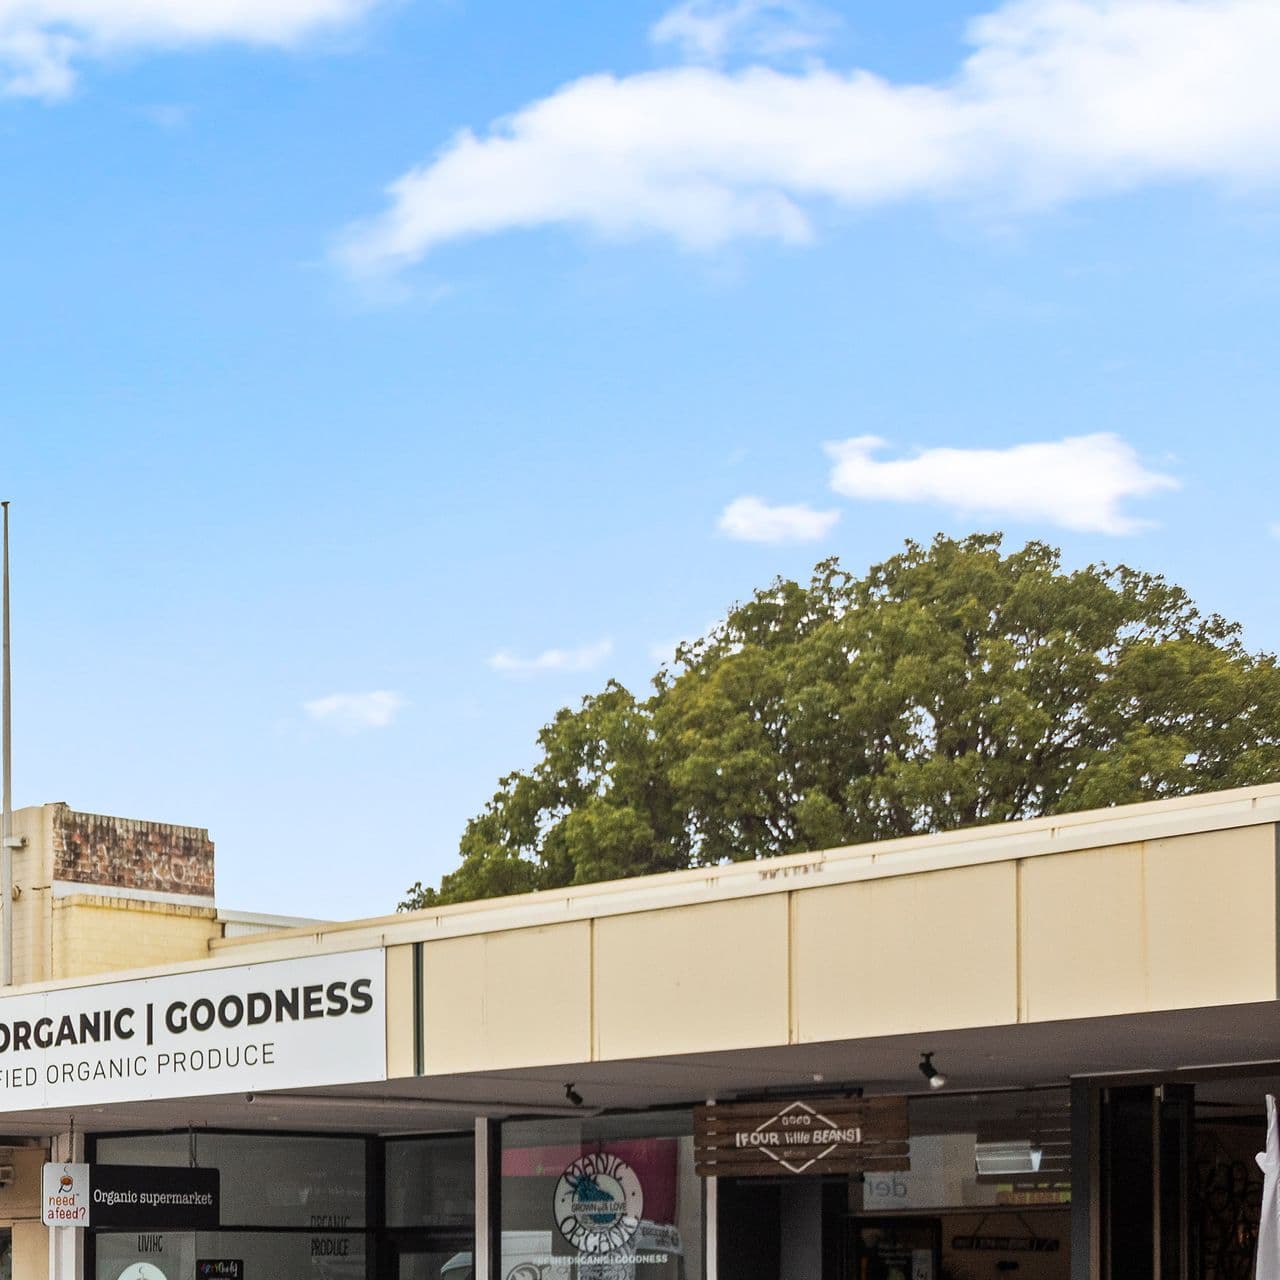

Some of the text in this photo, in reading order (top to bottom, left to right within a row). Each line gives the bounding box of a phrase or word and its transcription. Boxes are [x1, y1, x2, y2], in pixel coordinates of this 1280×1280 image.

[165, 978, 374, 1035] GOODNESS
[45, 1055, 148, 1084] ORGANIC
[157, 1042, 276, 1075] PRODUCE
[742, 1129, 855, 1147] FOUR little BEANS
[48, 1194, 75, 1206] need
[93, 1188, 213, 1206] Organic supermarket
[559, 1213, 639, 1253] ORGANIC
[615, 1255, 668, 1265] GOODNESS
